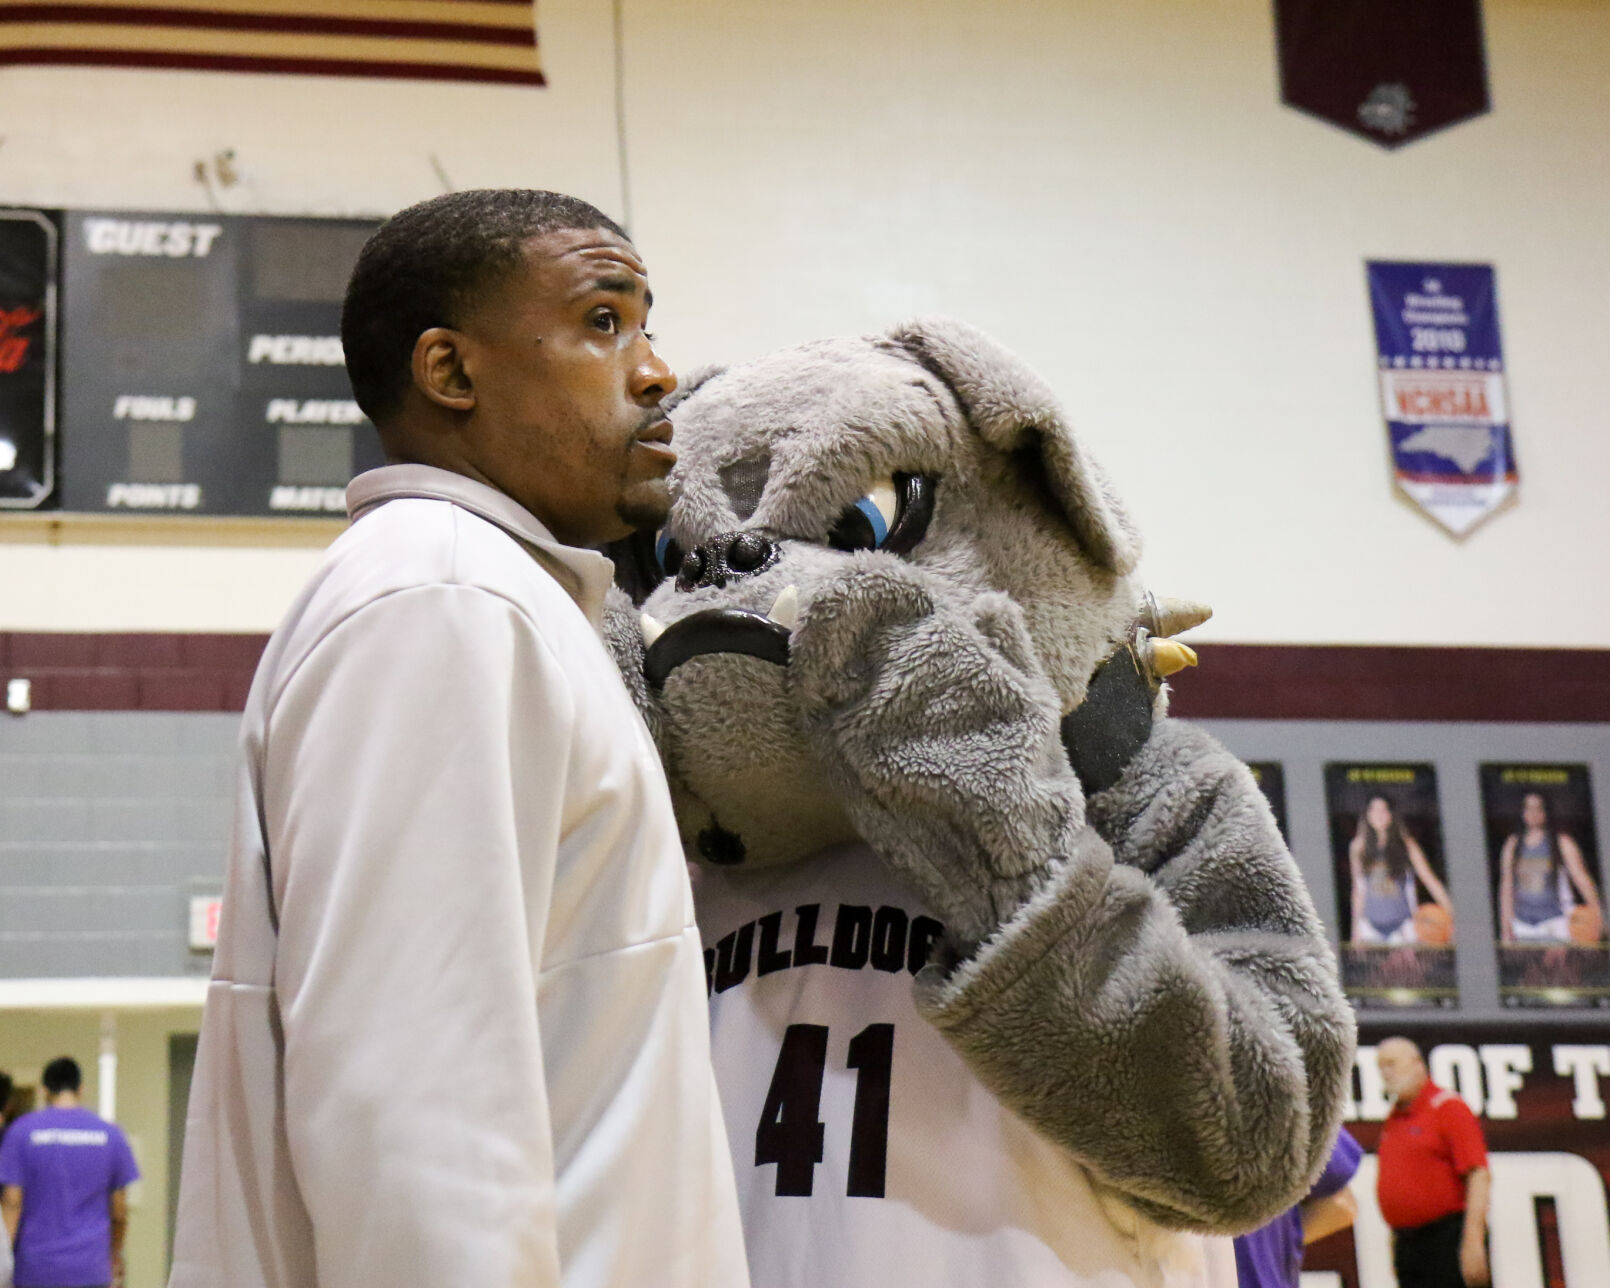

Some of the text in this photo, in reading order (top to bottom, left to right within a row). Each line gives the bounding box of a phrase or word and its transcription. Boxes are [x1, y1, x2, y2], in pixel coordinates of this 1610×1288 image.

[83, 218, 222, 257] GUEST
[112, 396, 197, 421] FOULS
[106, 484, 201, 509] POINTS
[1429, 1043, 1533, 1120] OF
[754, 1022, 895, 1198] 41
